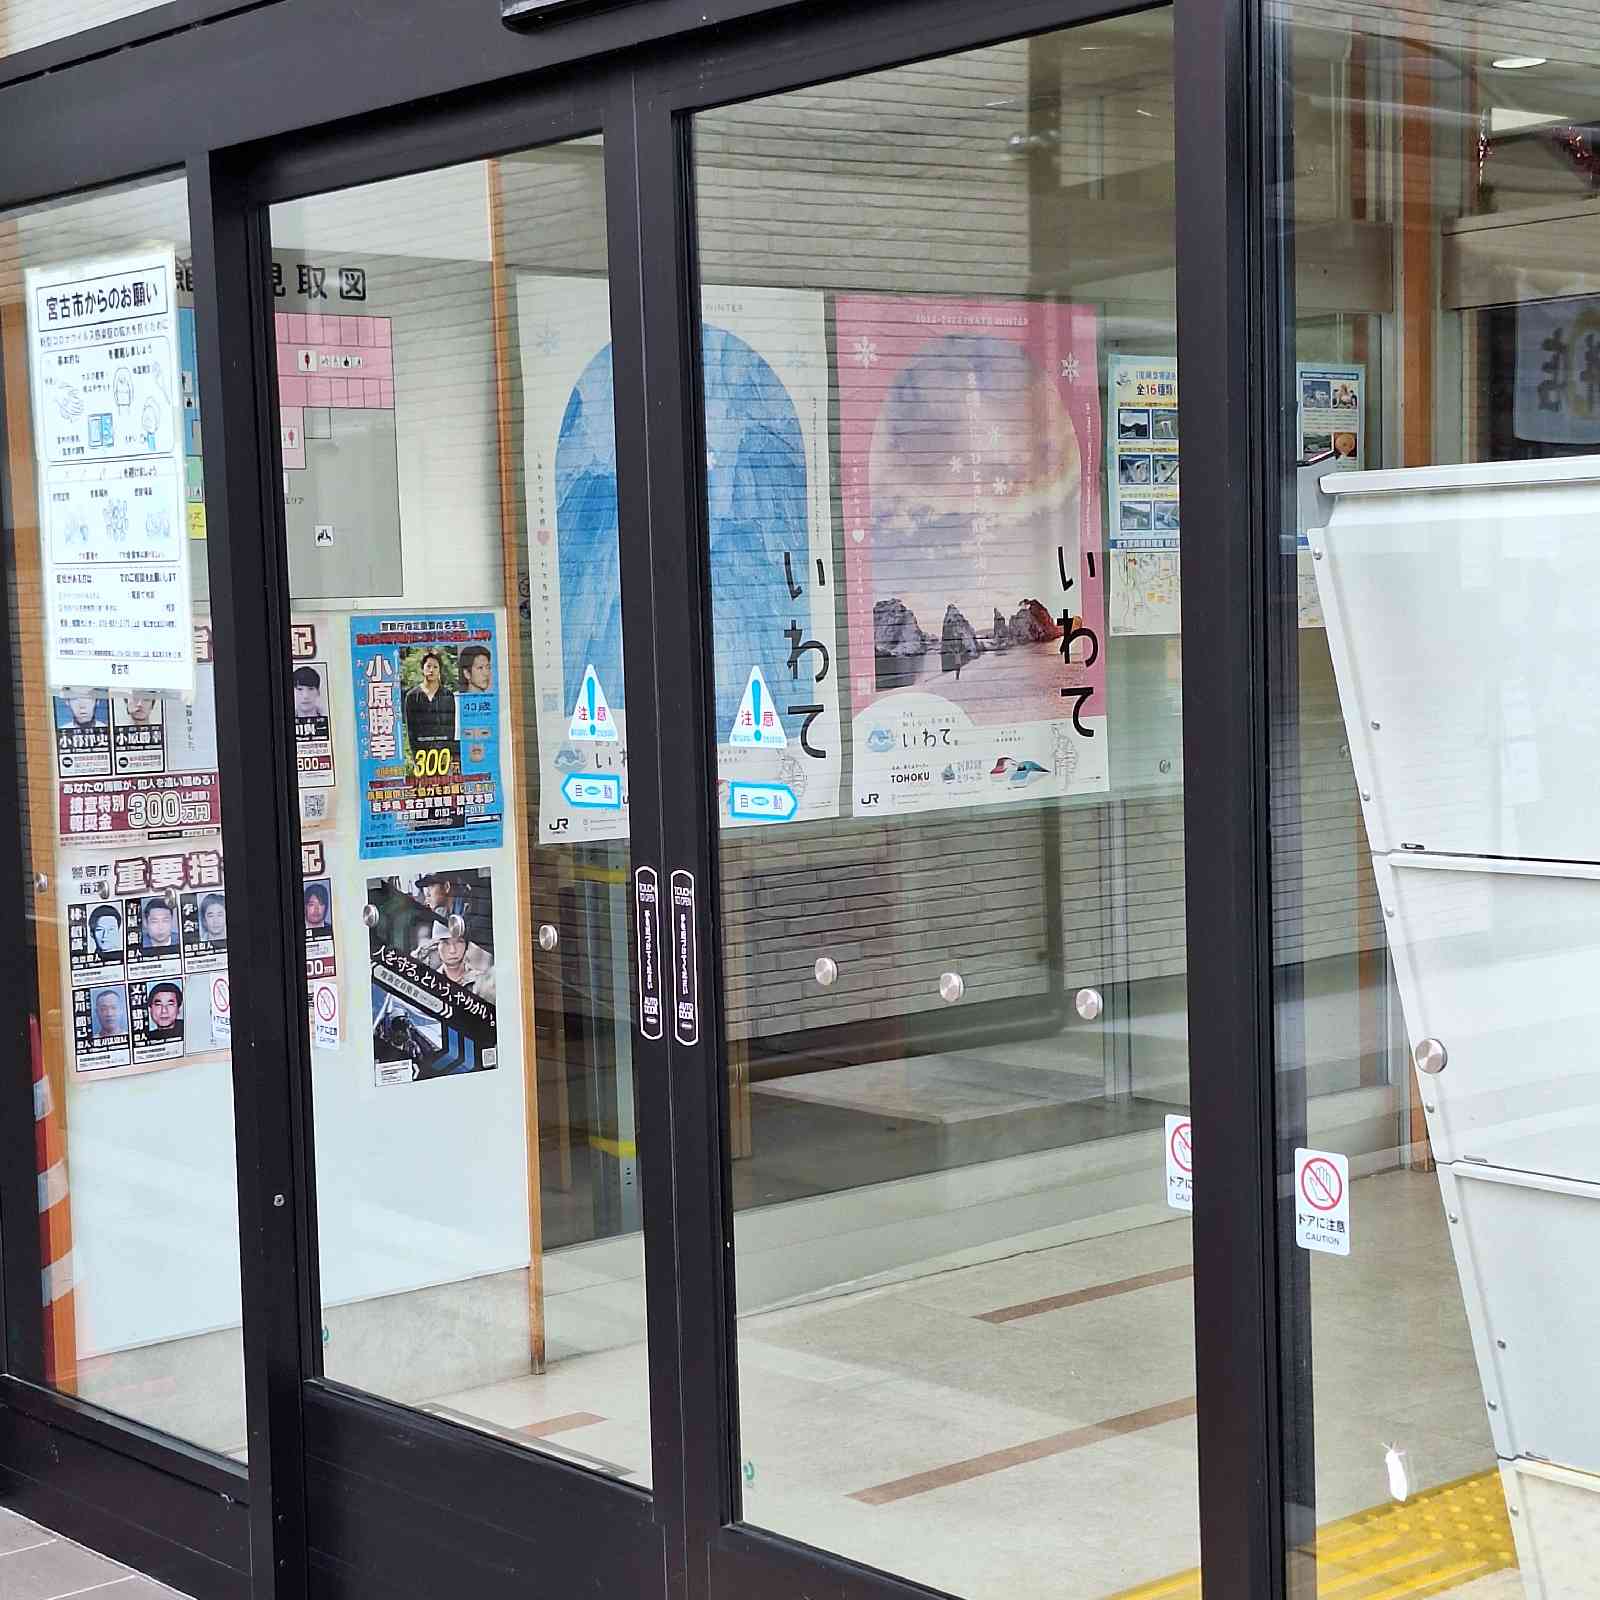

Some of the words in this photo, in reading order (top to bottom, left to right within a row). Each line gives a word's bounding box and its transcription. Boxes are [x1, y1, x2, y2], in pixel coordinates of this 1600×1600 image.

[46, 281, 158, 321] 宮古市からのお願い
[1056, 546, 1099, 738] いわて
[783, 551, 830, 759] いわて
[366, 654, 397, 761] 小原勝幸
[890, 772, 930, 784] TOHOKU
[861, 792, 880, 805] JR
[549, 817, 568, 831] JR
[1298, 1213, 1346, 1234] ドアに注意
[1305, 1232, 1340, 1246] CAUTION
